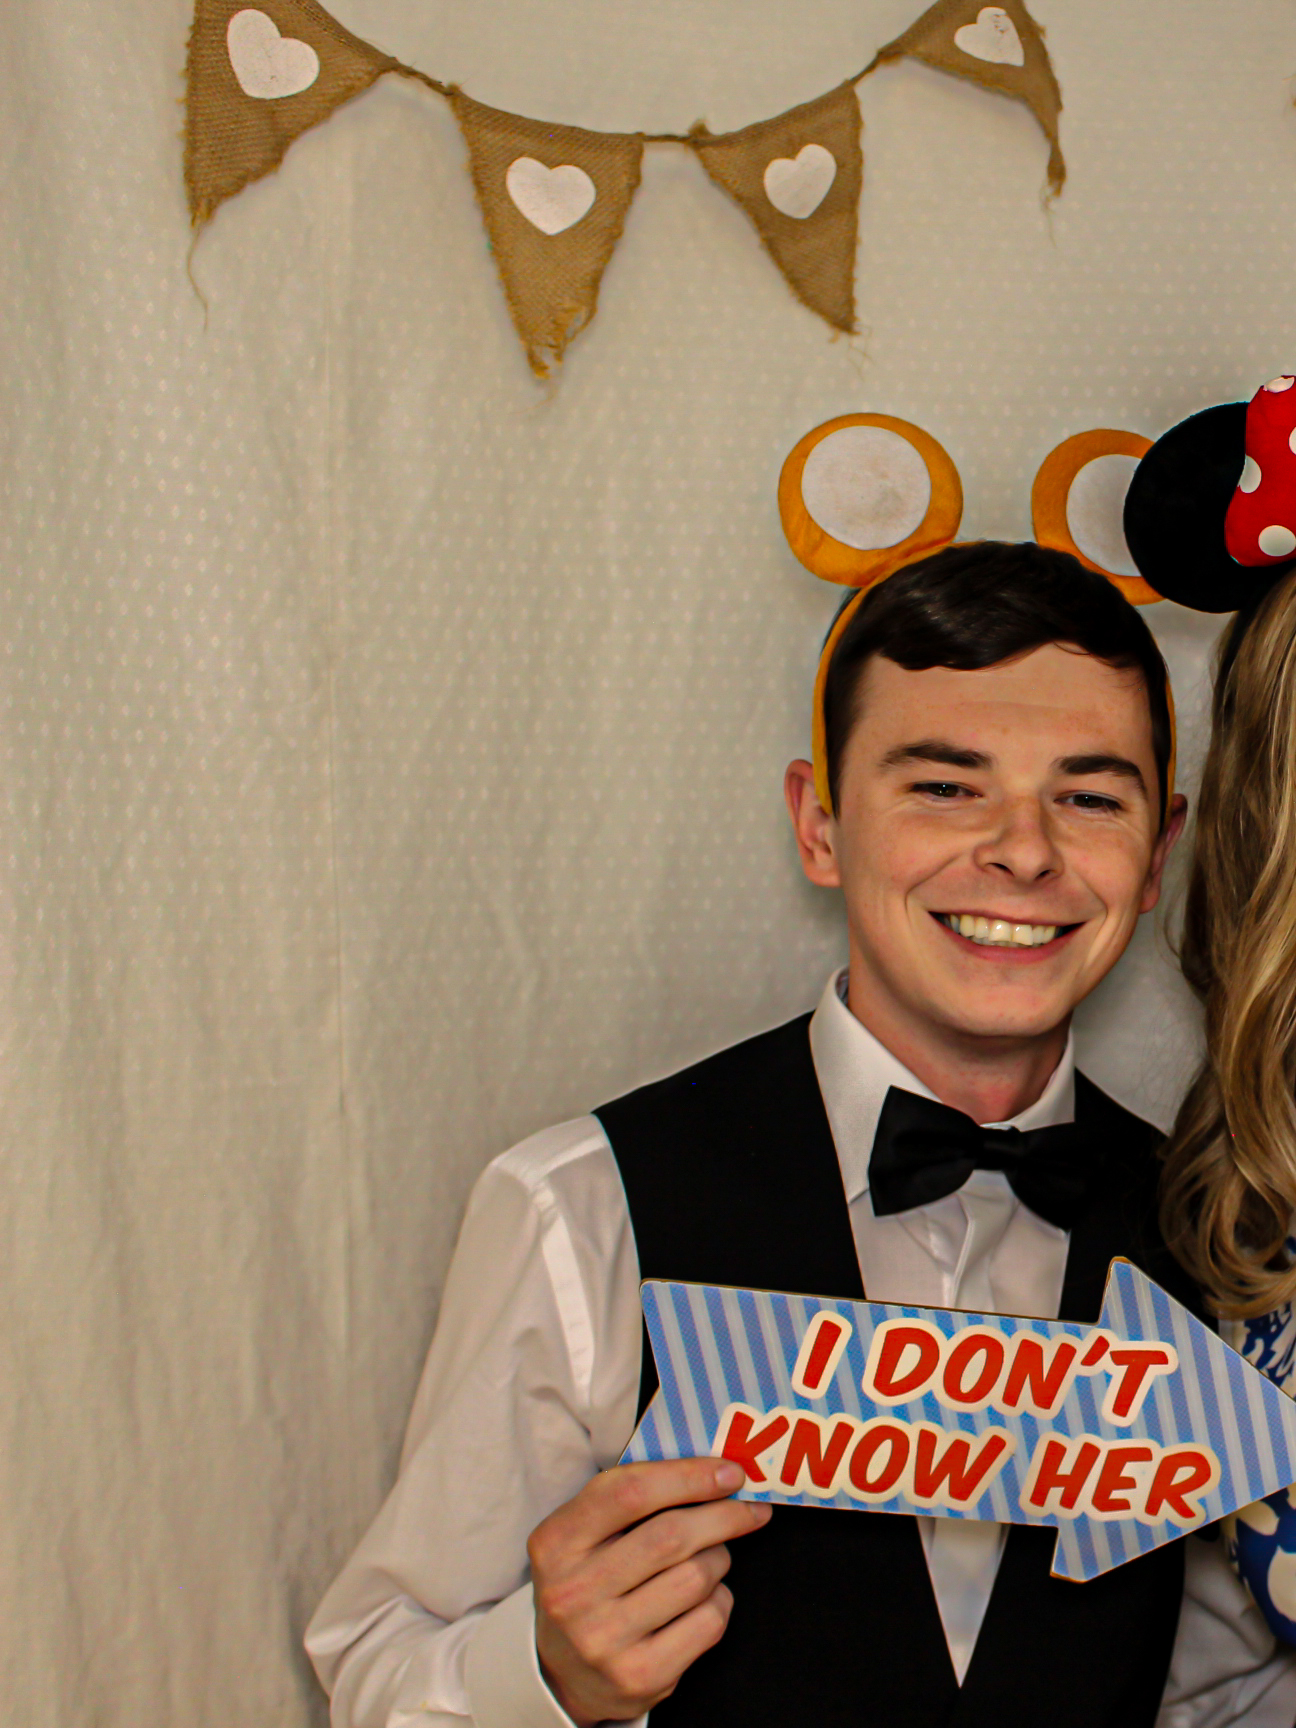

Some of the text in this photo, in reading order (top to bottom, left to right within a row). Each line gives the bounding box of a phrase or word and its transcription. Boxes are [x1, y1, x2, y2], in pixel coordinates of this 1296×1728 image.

[801, 1318, 1170, 1419] I DON'T
[721, 1410, 1213, 1520] KNOW HER
